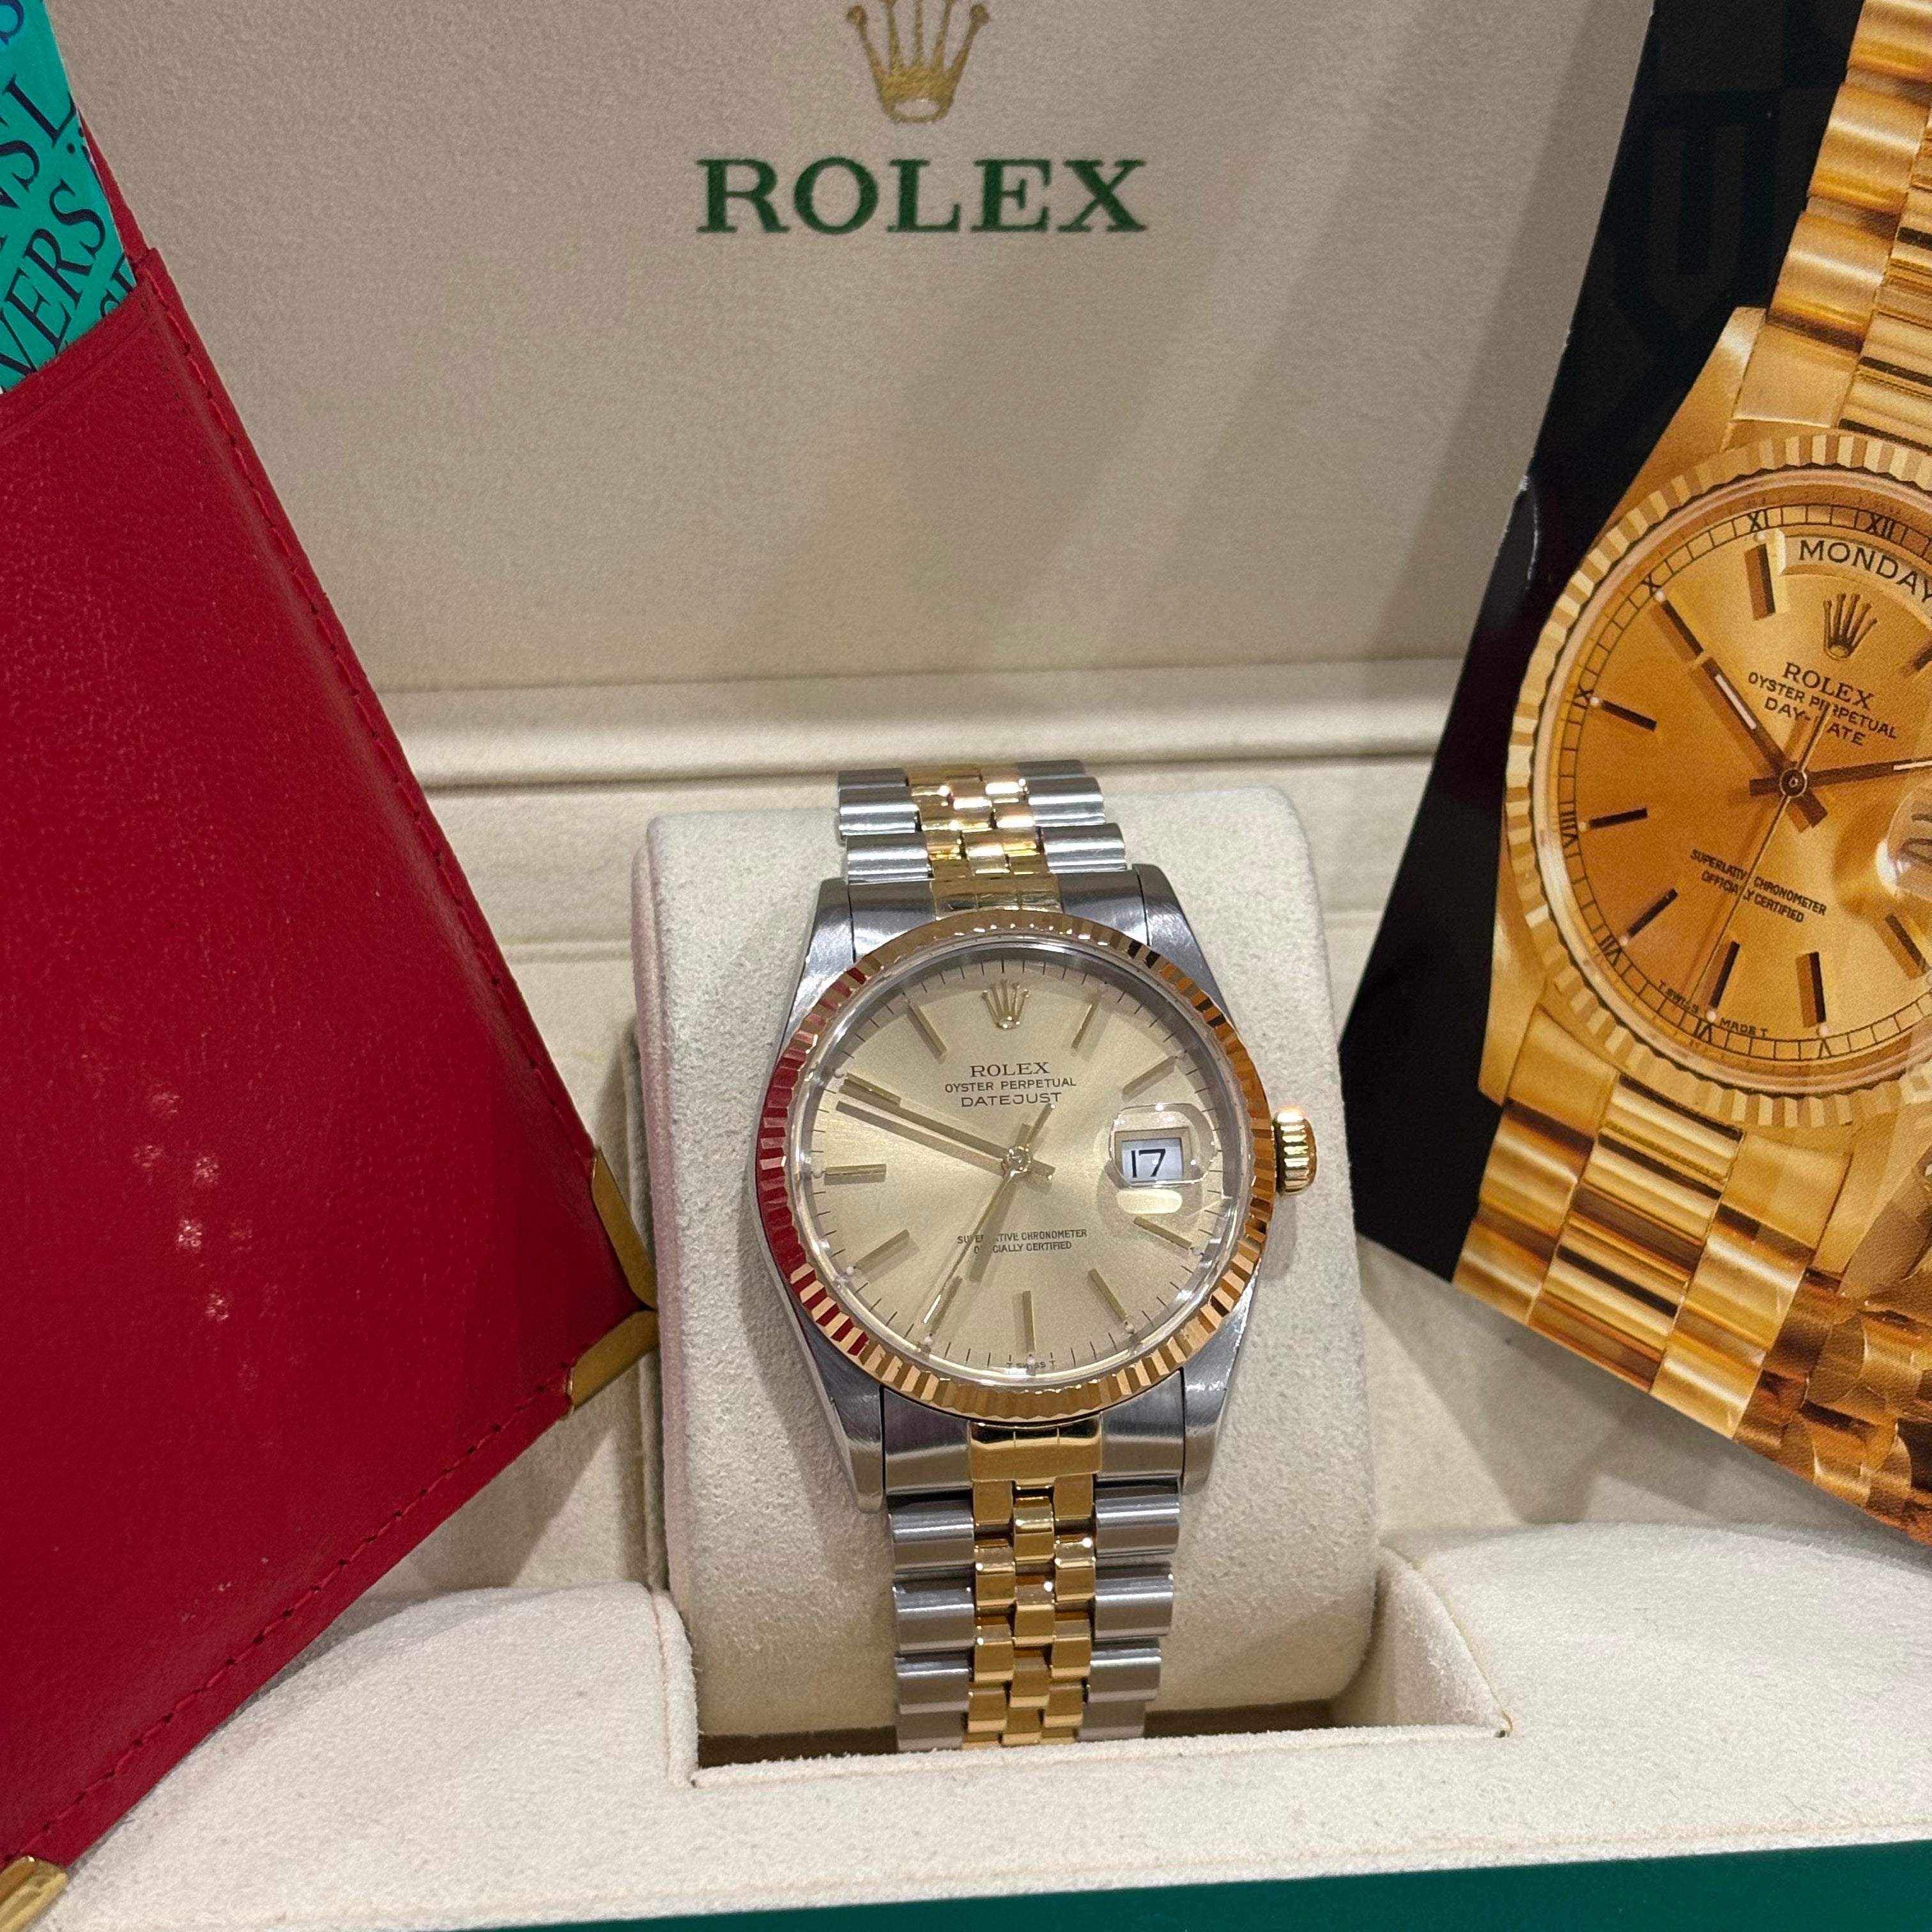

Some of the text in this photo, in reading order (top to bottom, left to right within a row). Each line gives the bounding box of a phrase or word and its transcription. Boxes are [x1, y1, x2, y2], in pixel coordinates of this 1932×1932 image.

[696, 157, 1147, 234] ROLEX
[1748, 671, 1897, 739] OYSTER PRPETUAL
[1782, 662, 1874, 711] ROLEX
[1765, 696, 1866, 746] DAY-ATE
[1690, 848, 1827, 916] SUPERLATIV CHRONOMETER
[1701, 870, 1804, 923] OFFICIAY CERTIFIED
[945, 1077, 1077, 1093] OYSTER PERPETUAL
[969, 1061, 1050, 1077] ROLEX
[961, 1092, 1062, 1107] DATEJUST
[1131, 1148, 1166, 1178] 17
[974, 1241, 1072, 1254] OCIALLY CERTIFIED
[1022, 1229, 1087, 1241] CHRONOMETER
